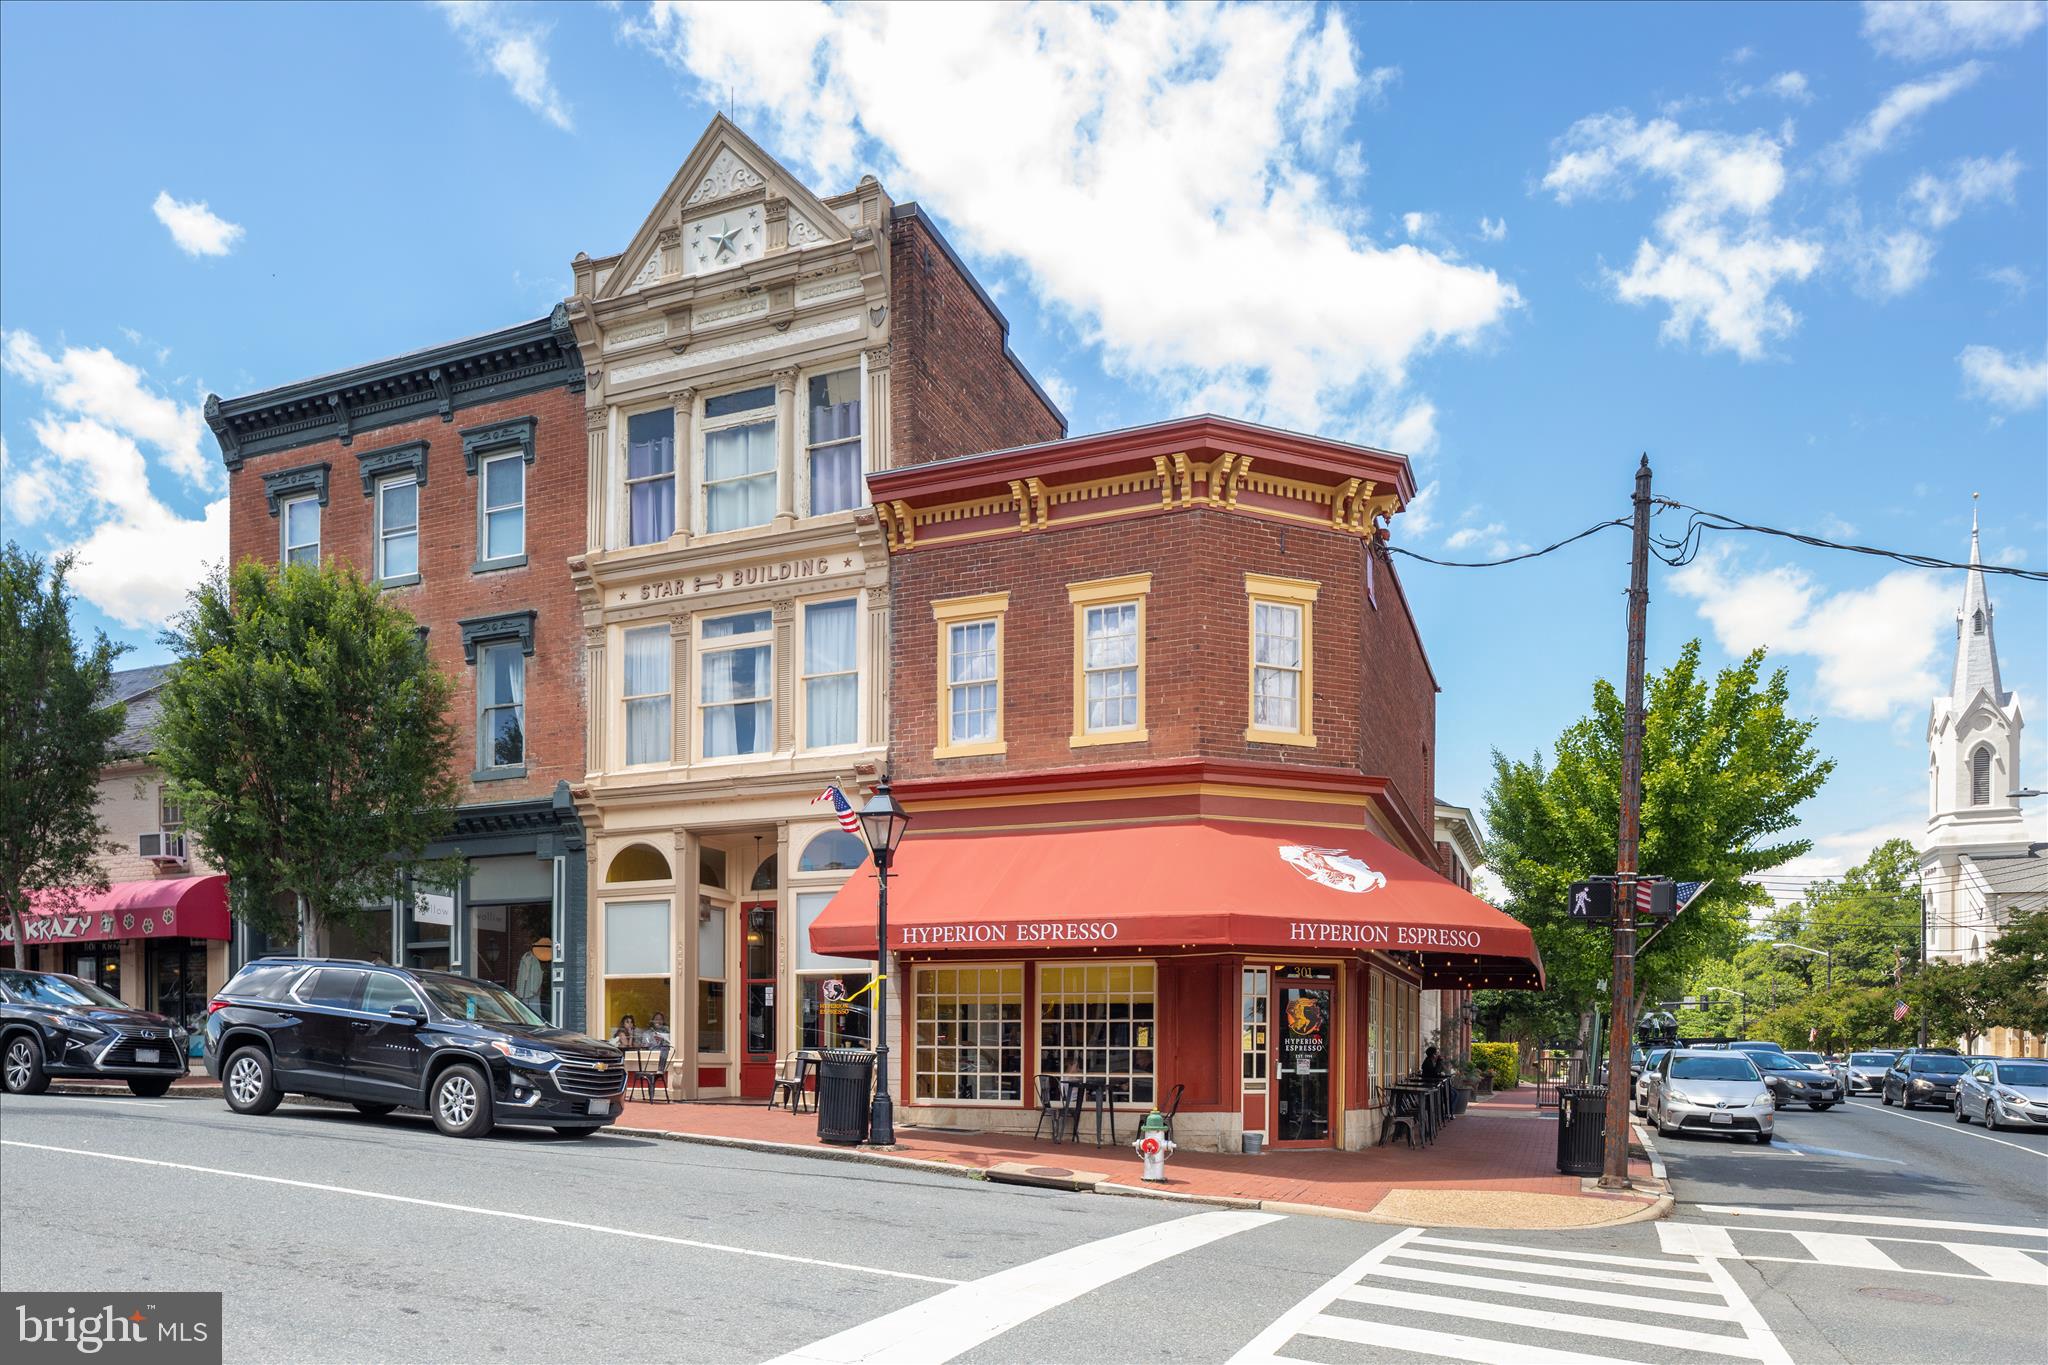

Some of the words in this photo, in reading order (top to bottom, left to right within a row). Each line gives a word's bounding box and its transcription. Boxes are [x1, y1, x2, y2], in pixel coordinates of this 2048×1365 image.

[639, 580, 684, 601] STAR
[733, 557, 829, 586] BUILDING
[25, 916, 92, 940] KRAZY
[902, 924, 1007, 944] HYPERION
[1016, 922, 1118, 942] ESPRESSO
[1290, 922, 1389, 943] HYPERION
[1397, 926, 1481, 948] ESPRESSO
[1294, 967, 1312, 978] 301
